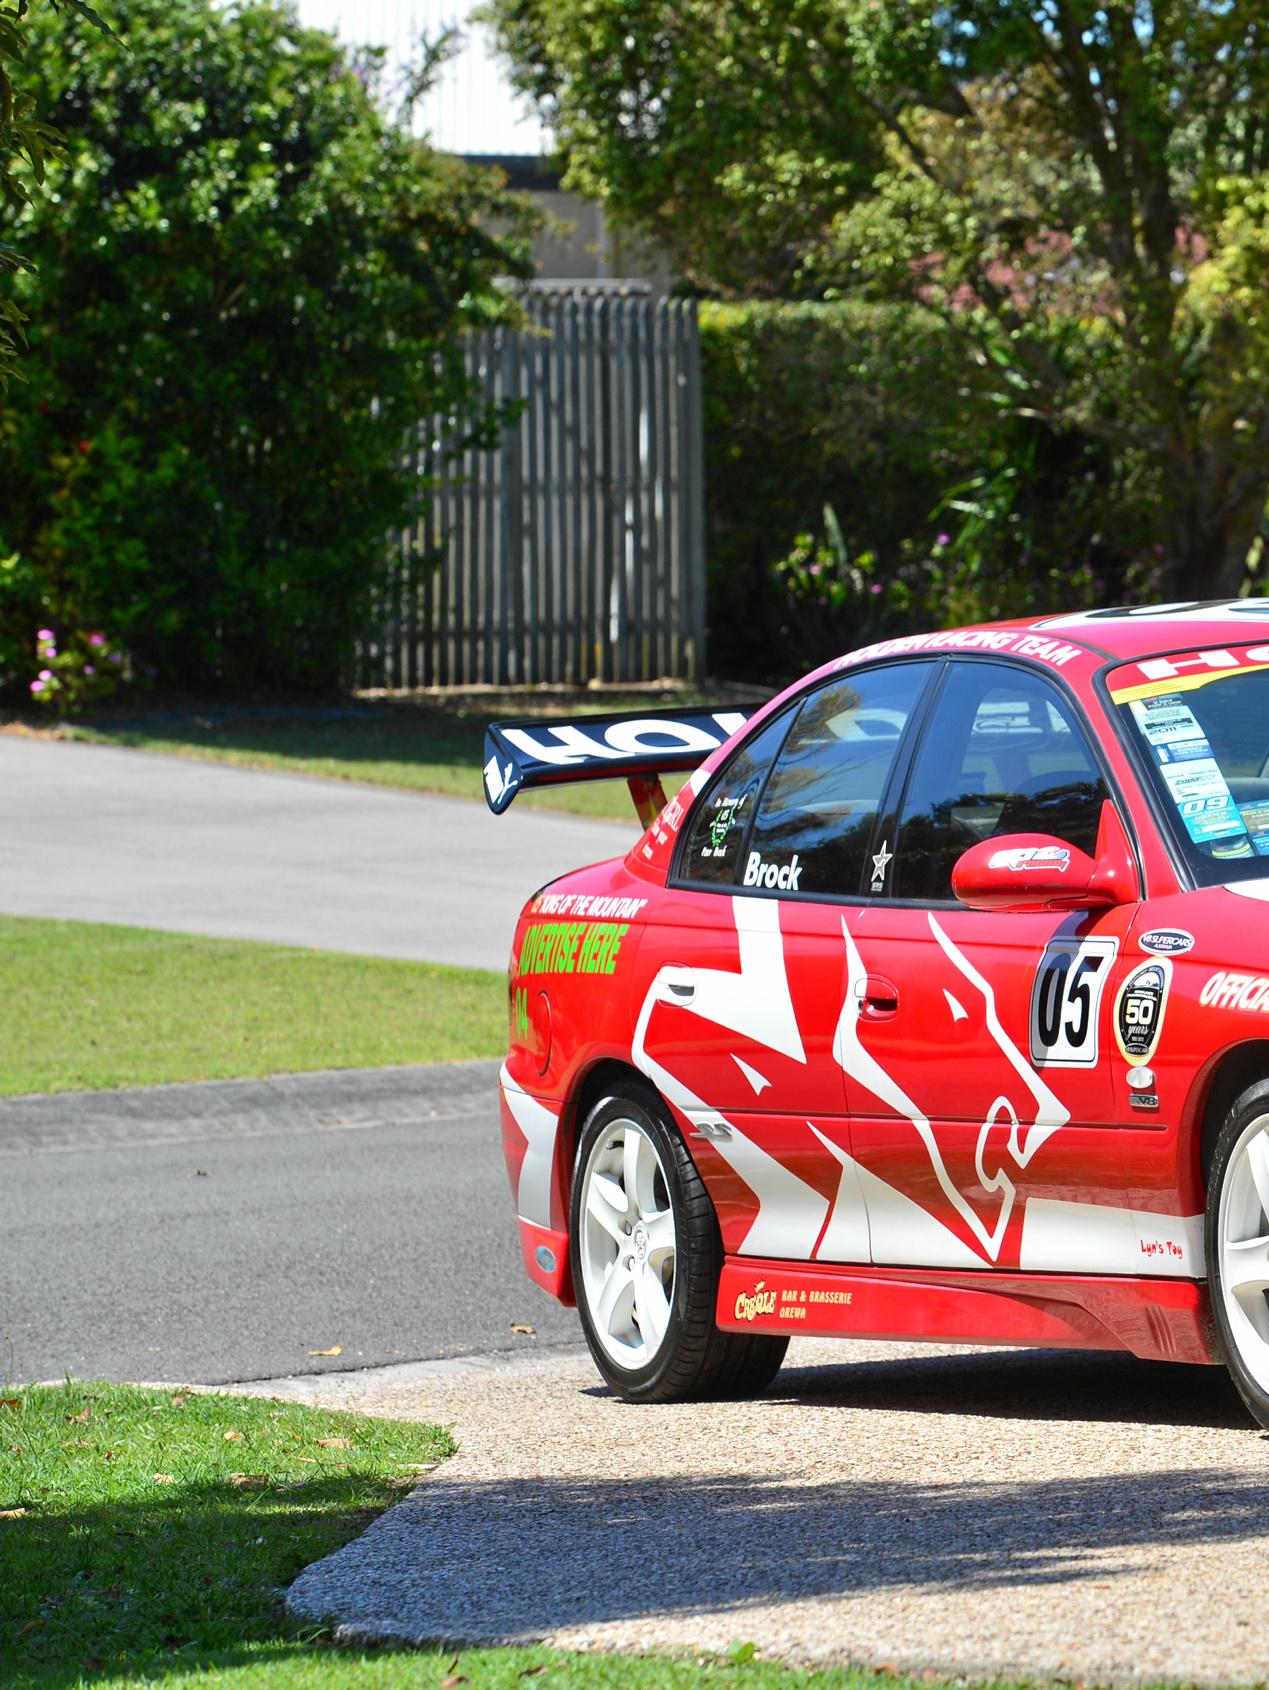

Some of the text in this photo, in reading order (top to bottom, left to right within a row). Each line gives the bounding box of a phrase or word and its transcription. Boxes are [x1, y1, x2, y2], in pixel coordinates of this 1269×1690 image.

[927, 631, 1018, 649] RACING
[1010, 635, 1082, 667] TEAM
[1183, 796, 1228, 815] 09
[743, 851, 803, 891] Brock
[557, 895, 578, 916] OF
[569, 895, 594, 917] THE
[517, 922, 630, 977] ADVERTISE HERE
[1038, 953, 1104, 1048] 05
[1125, 999, 1154, 1025] 50
[1127, 1024, 1149, 1041] years
[1140, 1240, 1183, 1260] Lyn's Toy
[781, 1290, 798, 1302] BAR
[799, 1290, 807, 1303] &
[809, 1290, 853, 1305] BRASSERIE
[779, 1306, 806, 1319] OREWA
